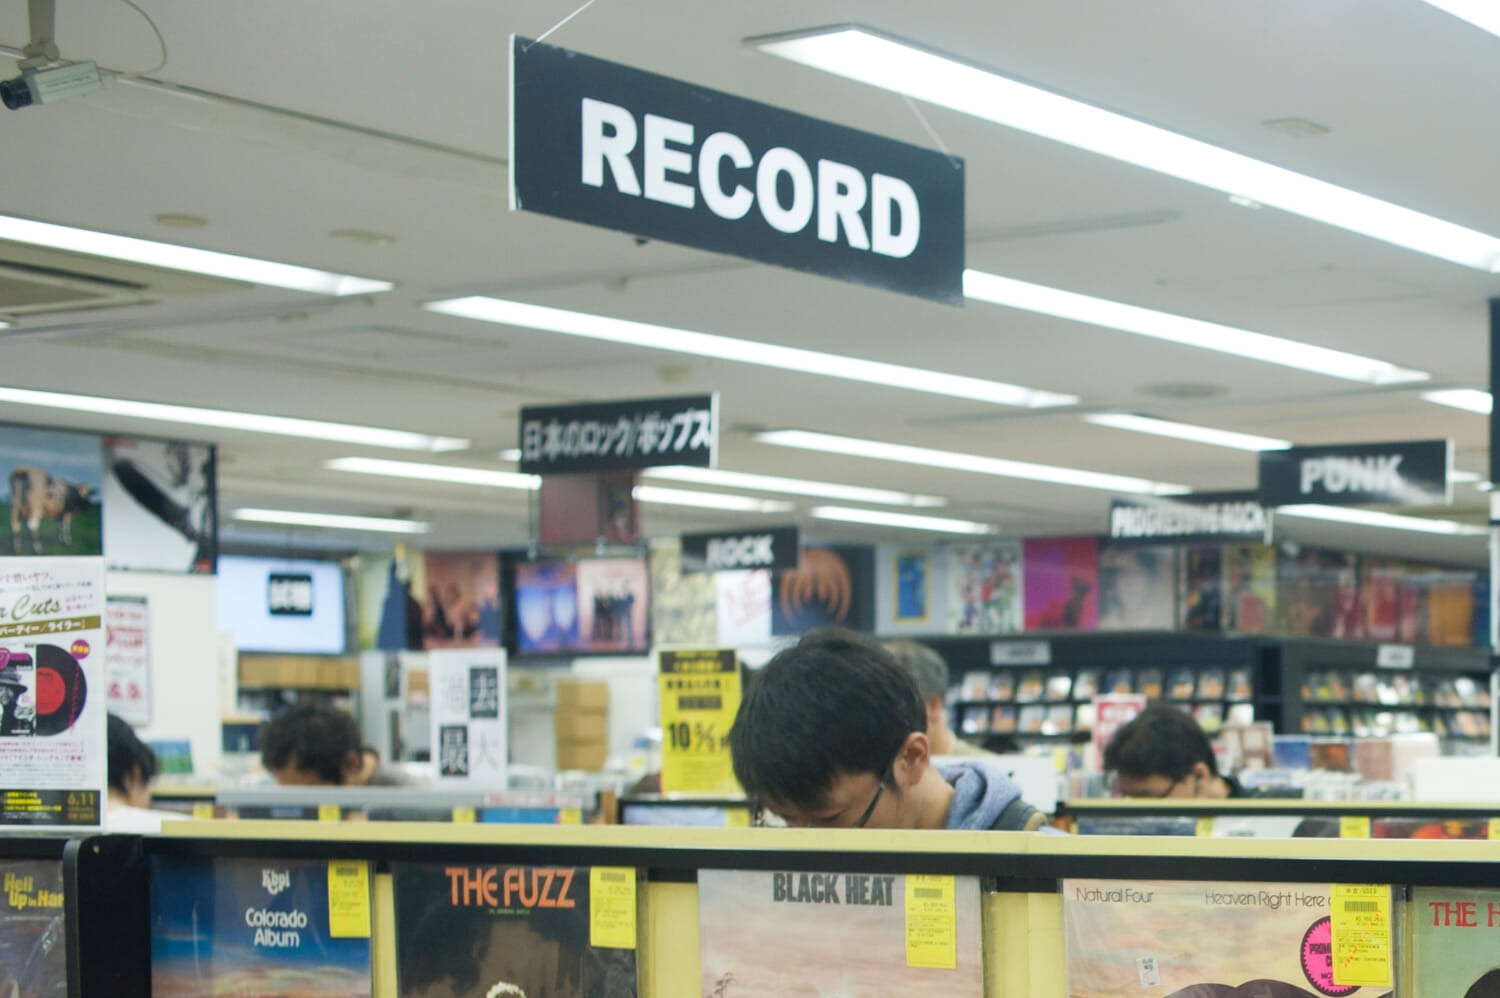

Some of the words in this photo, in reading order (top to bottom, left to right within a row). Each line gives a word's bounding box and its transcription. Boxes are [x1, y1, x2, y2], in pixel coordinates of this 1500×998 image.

[581, 97, 921, 259] RECORD
[523, 409, 711, 462] 日本のロック/ポップス
[1301, 455, 1403, 494] PUNK
[706, 535, 774, 569] ROCK
[445, 868, 498, 907] THE
[504, 868, 575, 908] FUZZ
[773, 872, 841, 904] BLACK
[845, 875, 895, 907] HEAT
[1076, 887, 1123, 903] Natural
[1125, 888, 1153, 904] Four
[1205, 892, 1256, 906] Heaven
[1258, 891, 1292, 910] Right
[1295, 892, 1324, 908] Here
[245, 907, 308, 929] Colorado
[1429, 901, 1477, 928] THE
[254, 927, 300, 948] Album
